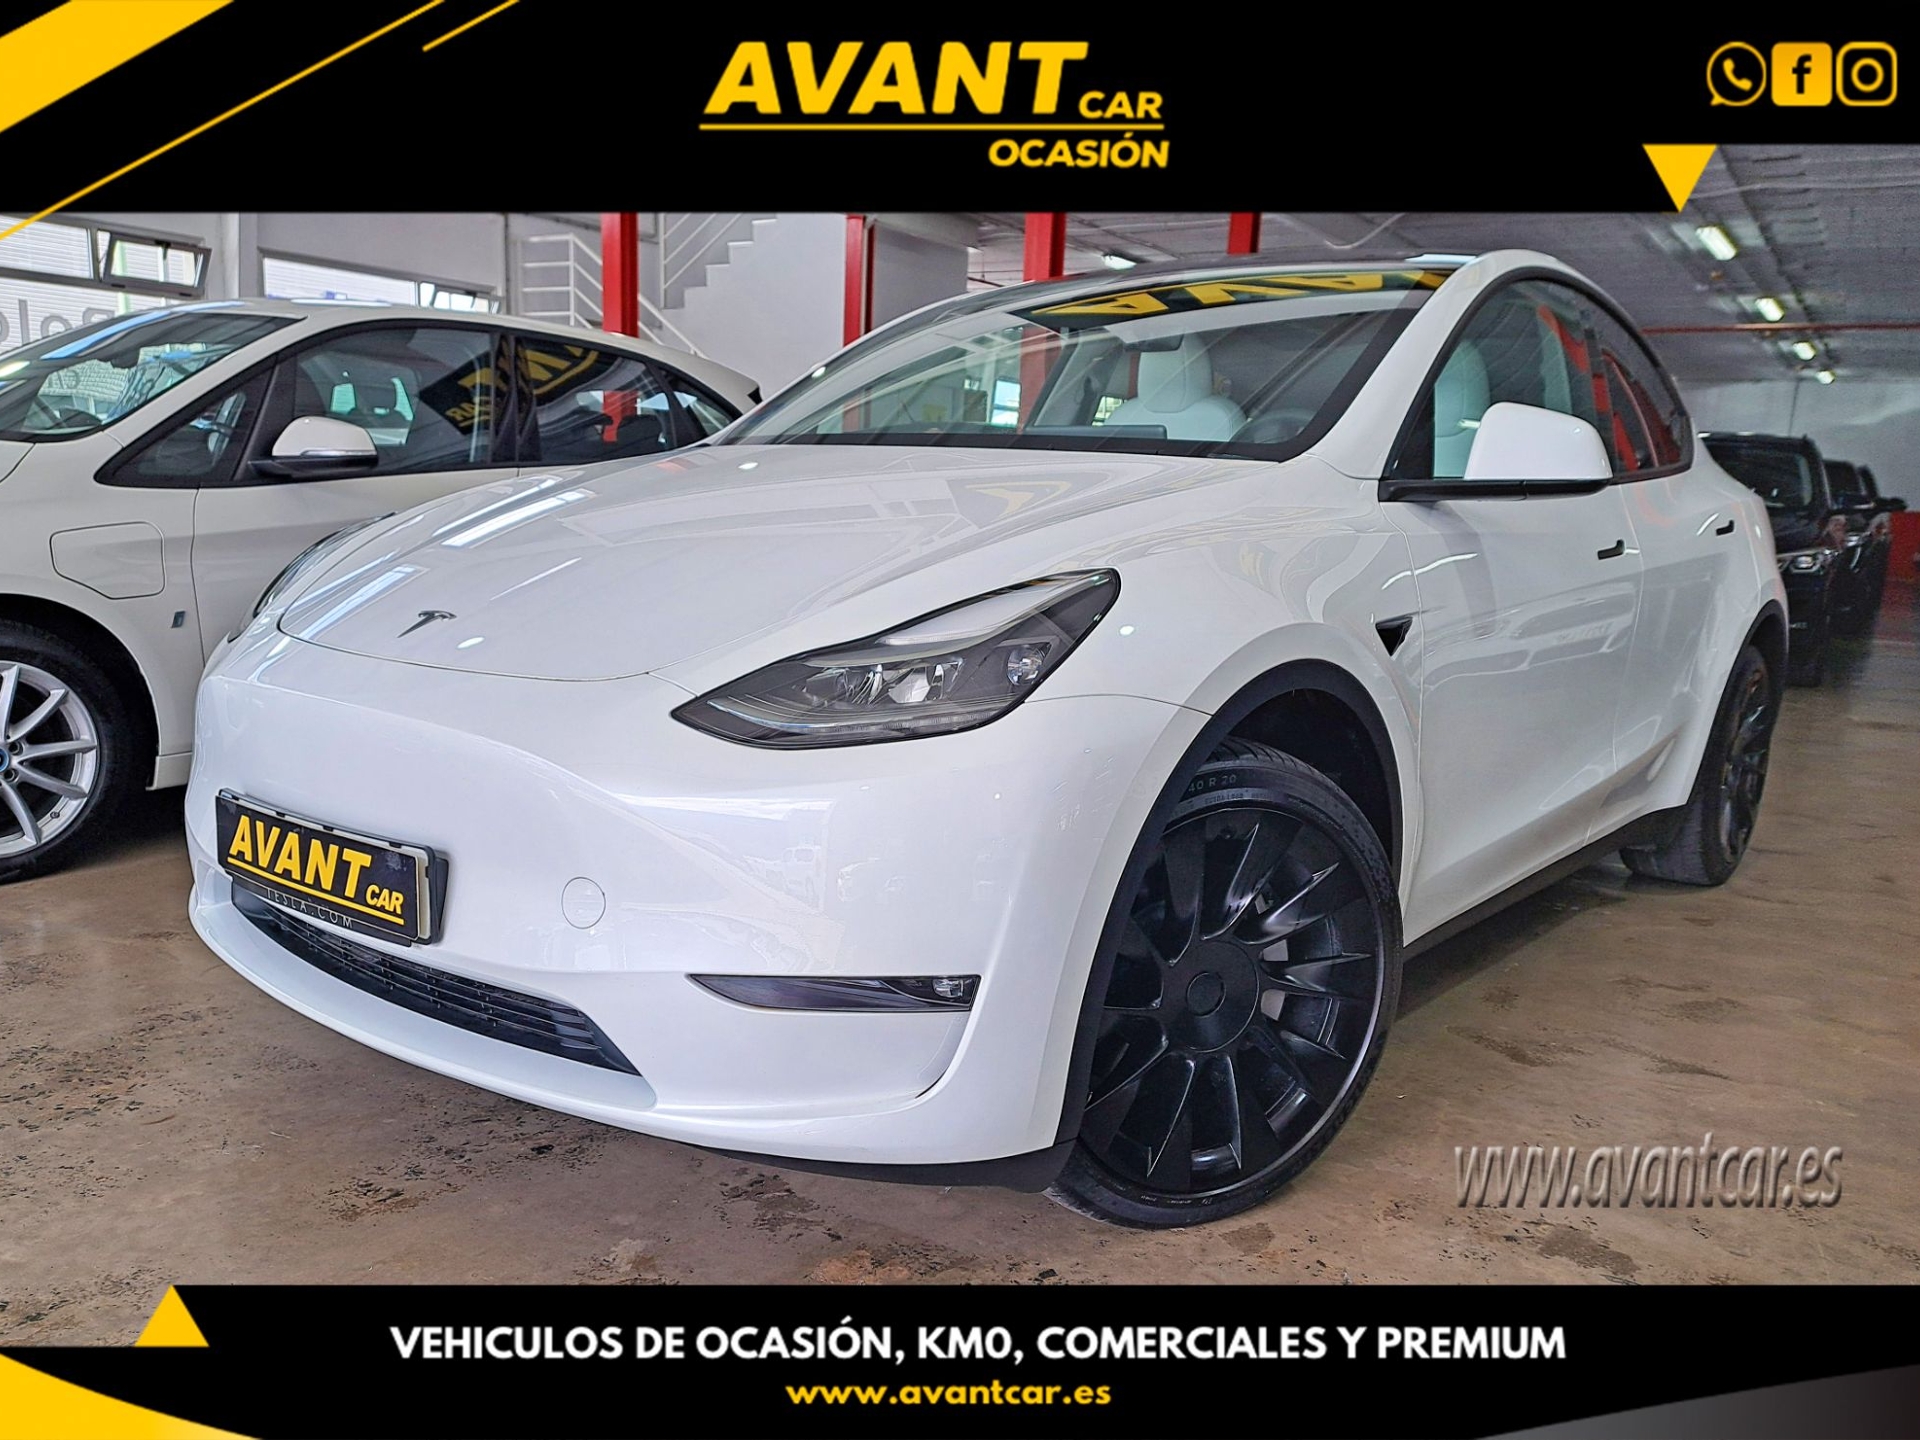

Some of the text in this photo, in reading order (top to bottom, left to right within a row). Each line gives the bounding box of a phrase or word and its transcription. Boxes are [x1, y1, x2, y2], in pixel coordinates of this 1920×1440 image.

[228, 814, 405, 915] AVANT CAR
[266, 886, 354, 929] TESLA.COM
